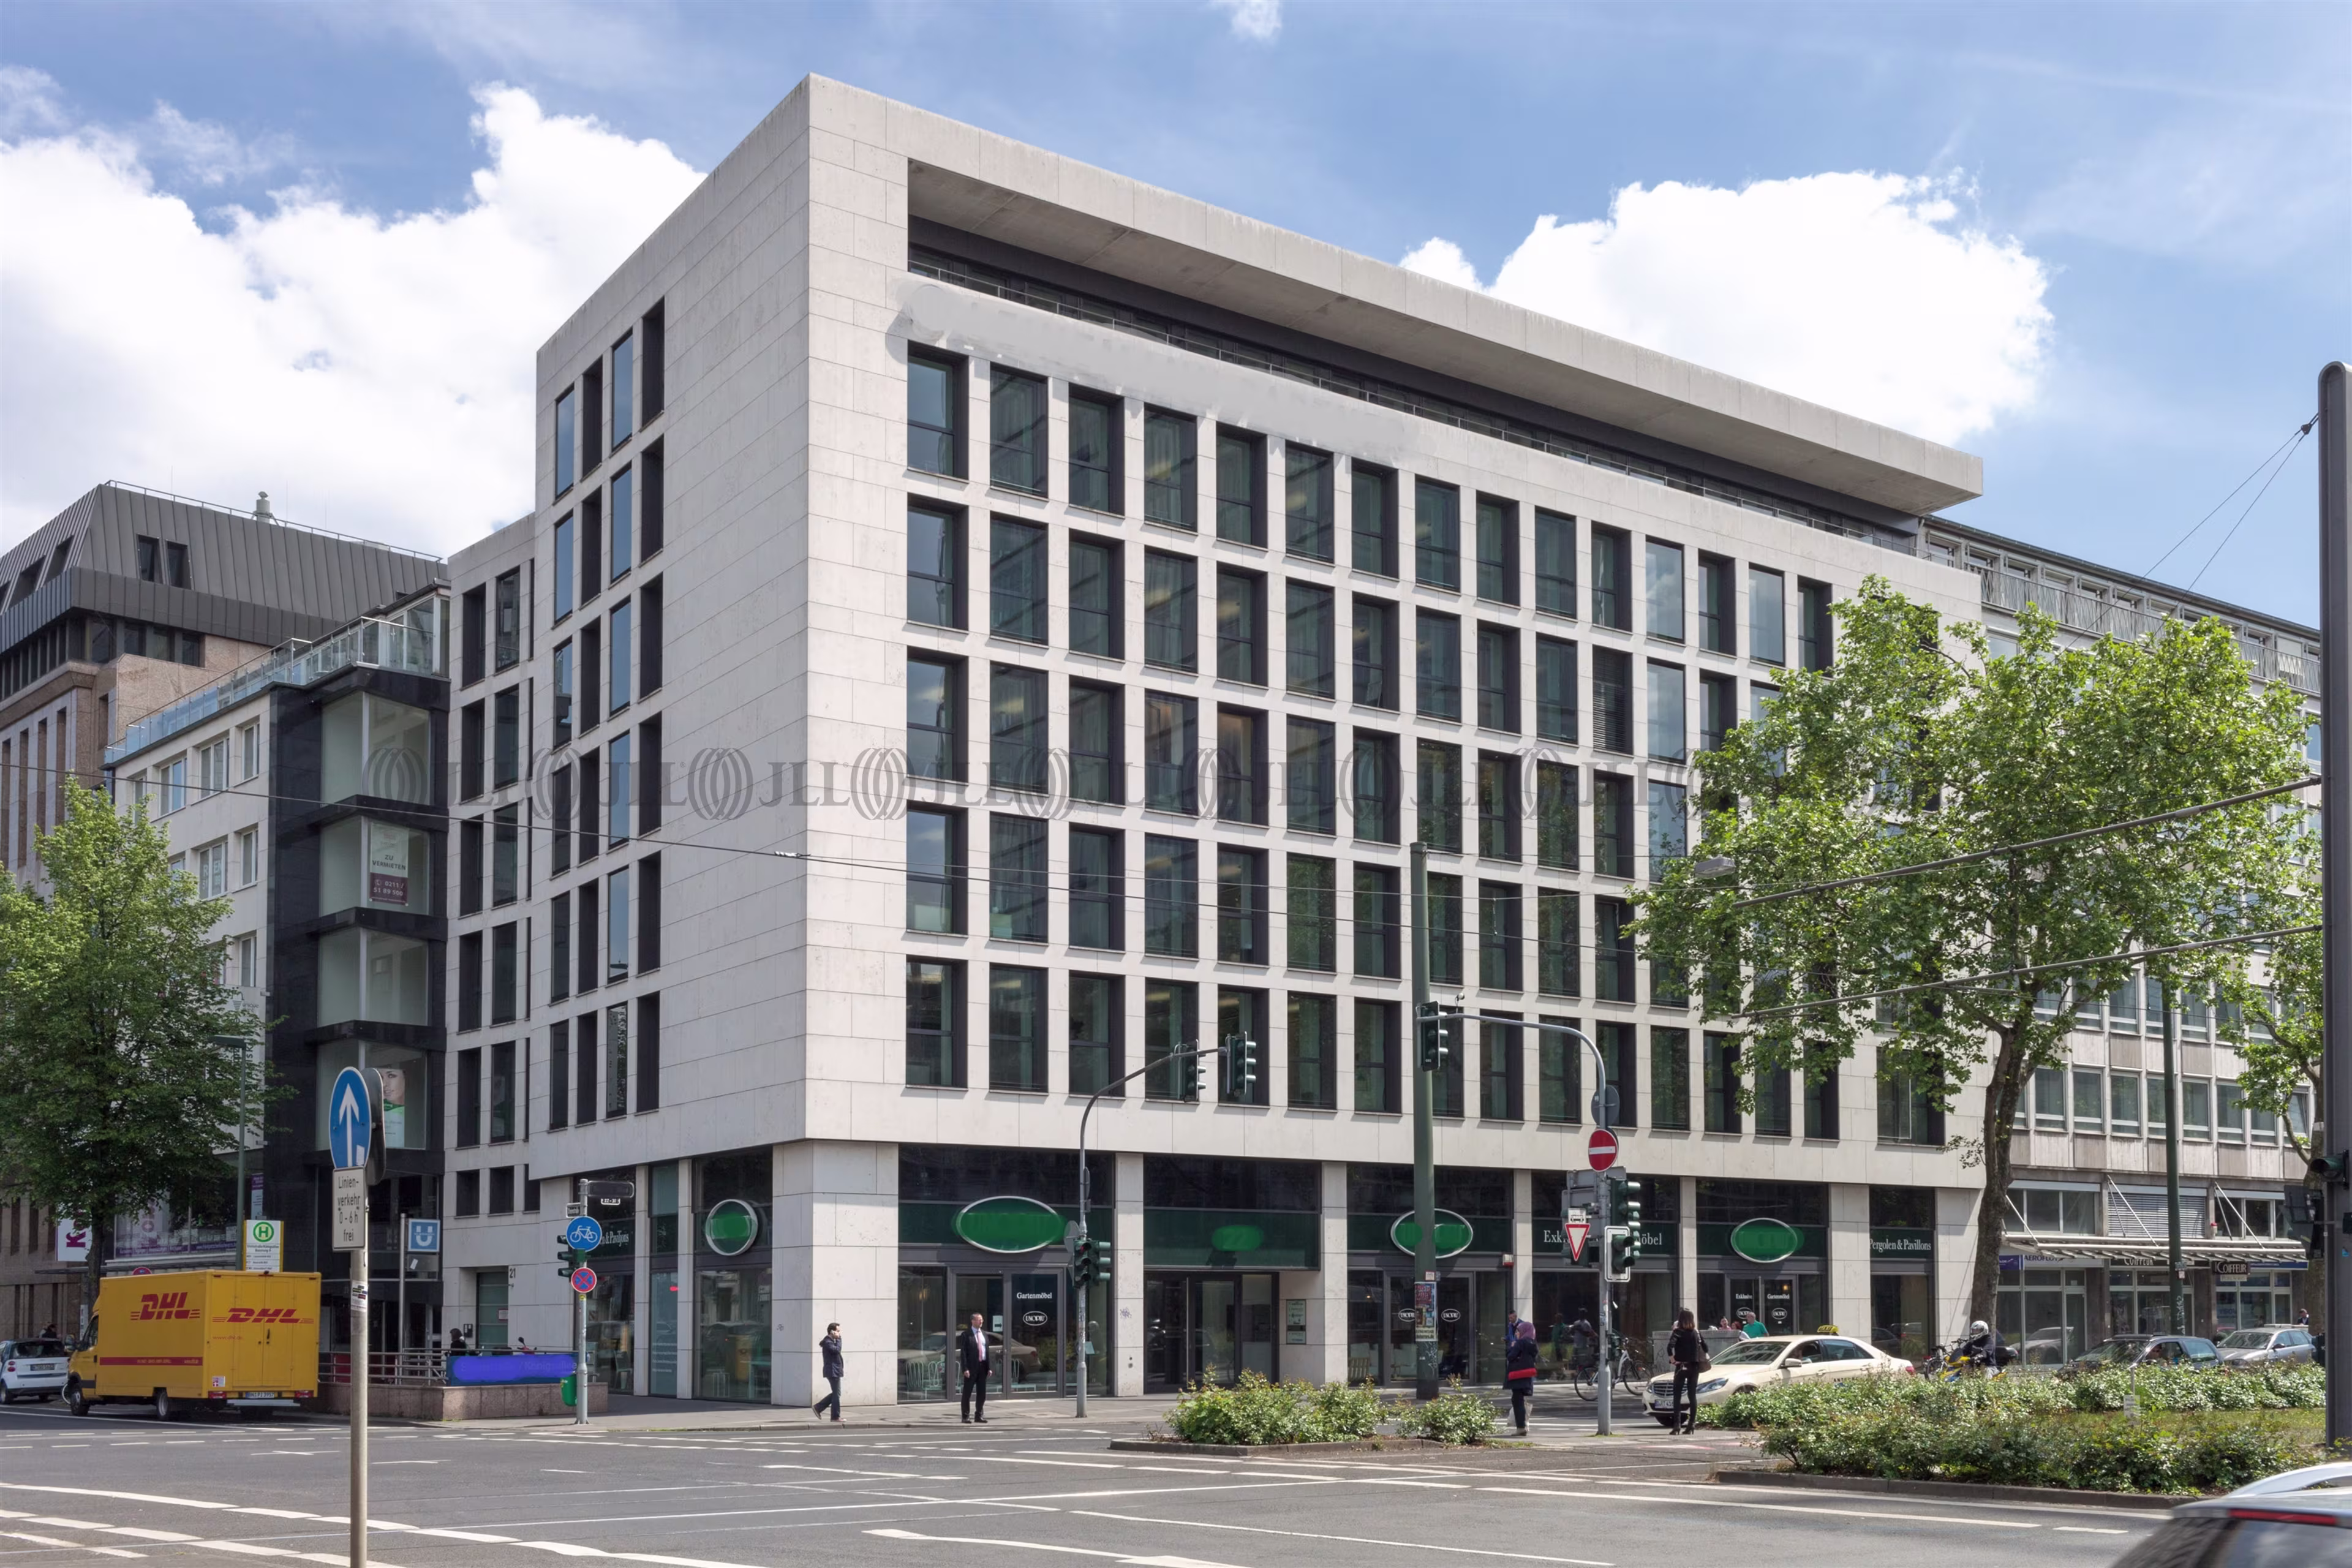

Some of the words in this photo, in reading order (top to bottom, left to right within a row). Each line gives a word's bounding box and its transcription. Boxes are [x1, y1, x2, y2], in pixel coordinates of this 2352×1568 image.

[372, 860, 406, 870] VERMIETEN
[338, 1176, 359, 1189] Linien-
[337, 1193, 360, 1206] verkehr
[258, 1226, 268, 1238] H
[343, 1229, 354, 1242] frei
[1869, 1238, 1897, 1253] Pergolen
[1897, 1239, 1903, 1250] &
[1904, 1239, 1932, 1251] Pavillons
[510, 1268, 516, 1278] 21
[140, 1292, 190, 1321] DHL
[227, 1308, 300, 1324] DHL
